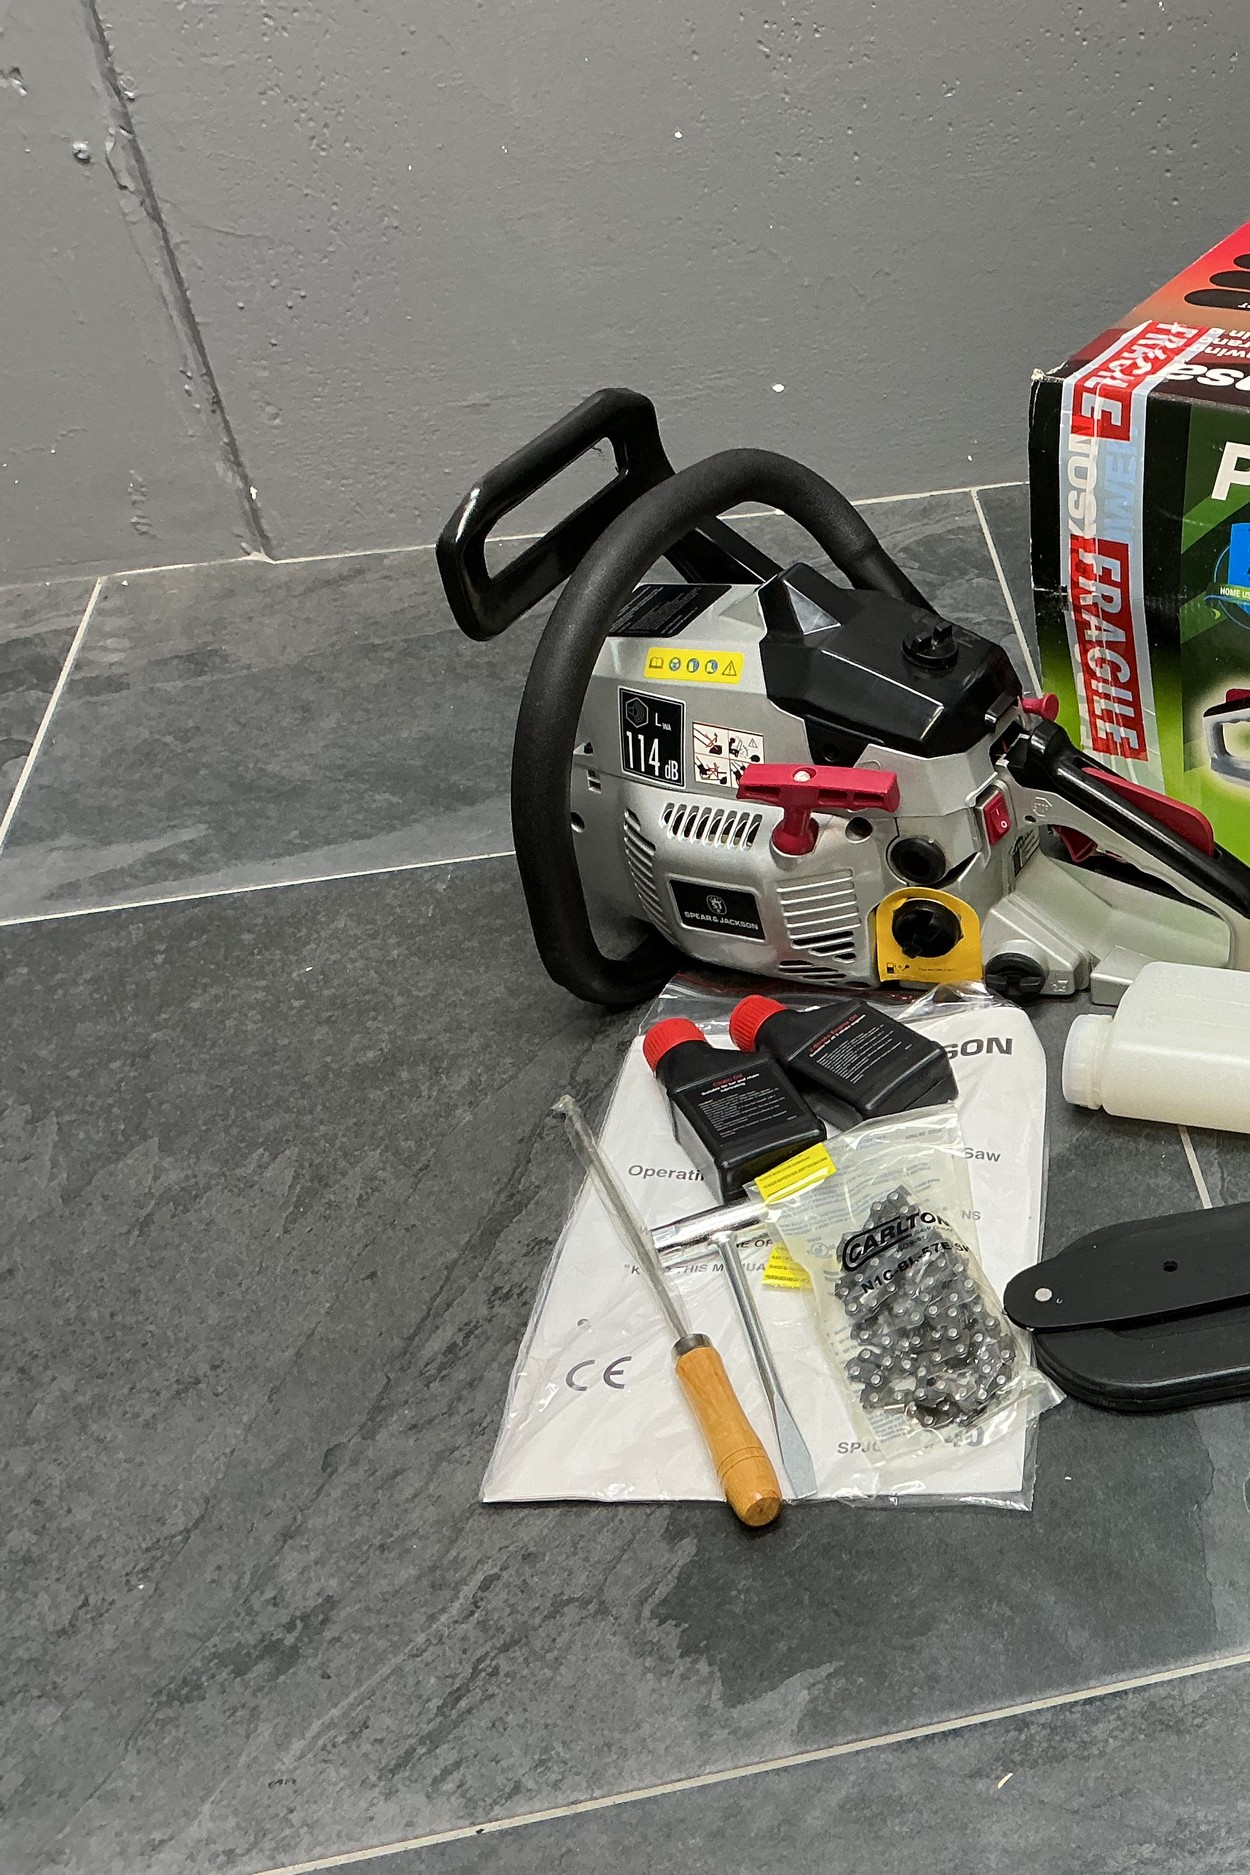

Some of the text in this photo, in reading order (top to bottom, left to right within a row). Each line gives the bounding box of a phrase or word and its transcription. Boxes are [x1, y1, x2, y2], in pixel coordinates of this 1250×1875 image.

[1219, 586, 1241, 598] HOME
[1079, 548, 1140, 752] FRAGILE
[625, 730, 680, 781] 114 dB
[684, 910, 712, 924] SPEAR
[720, 915, 760, 932] JACKSON
[964, 1147, 1001, 1163] Saw
[848, 1211, 952, 1264] CARLTON
